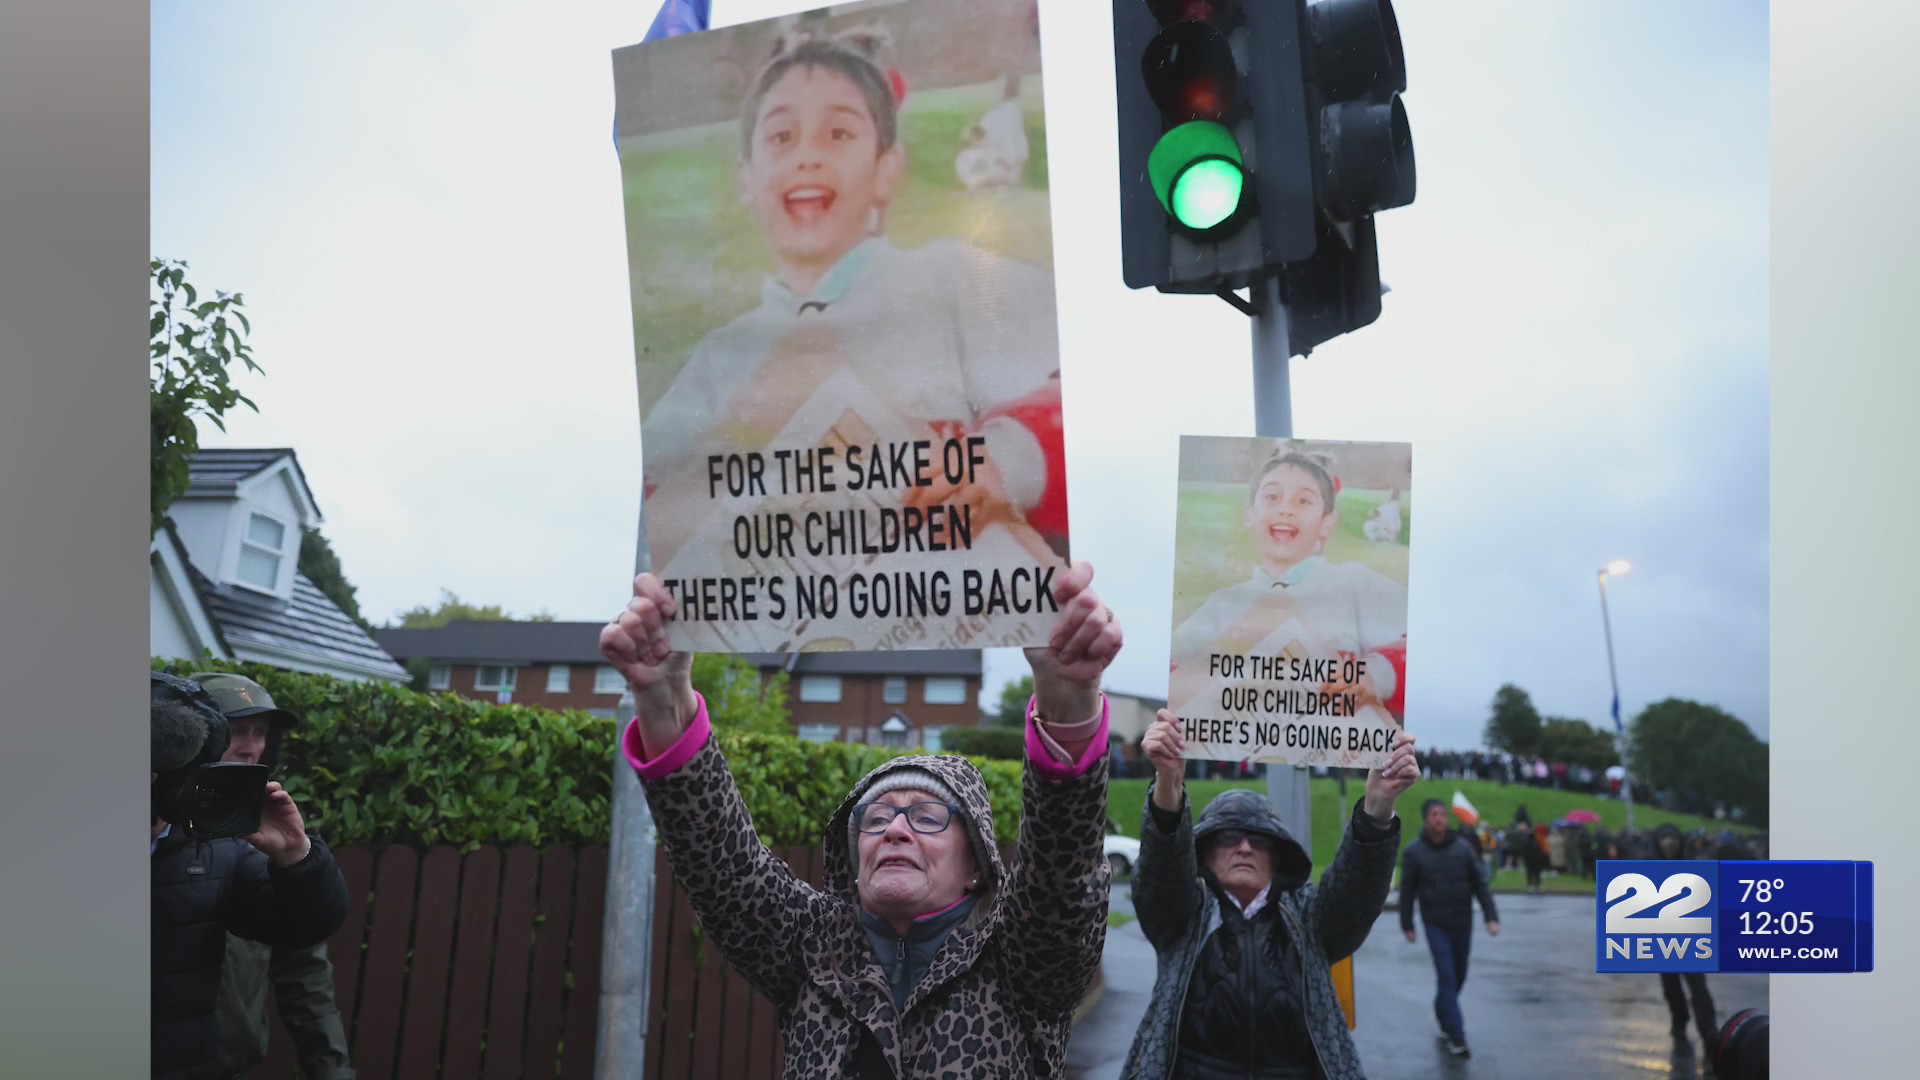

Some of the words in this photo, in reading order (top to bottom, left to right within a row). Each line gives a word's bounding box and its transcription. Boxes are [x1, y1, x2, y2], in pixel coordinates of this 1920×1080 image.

[707, 452, 767, 499] FOR
[774, 446, 837, 495] THE
[845, 440, 933, 491] SAKE
[942, 436, 986, 486] OF
[733, 513, 796, 560] OUR
[804, 503, 973, 558] CHILDREN
[663, 576, 785, 622] THERE'S
[795, 574, 839, 621] NO
[849, 570, 952, 619] GOING
[962, 566, 1060, 617] BACK
[1209, 653, 1245, 680] FOR
[1250, 655, 1286, 682] THE
[1290, 657, 1338, 685] SAKE
[1342, 659, 1367, 685] OF
[1221, 687, 1259, 713] OUR
[1263, 689, 1356, 718] CHILDREN
[1178, 717, 1250, 746] HERE'S
[1255, 721, 1281, 748] NO
[1286, 723, 1342, 751] GOING
[1348, 727, 1397, 753] BACK
